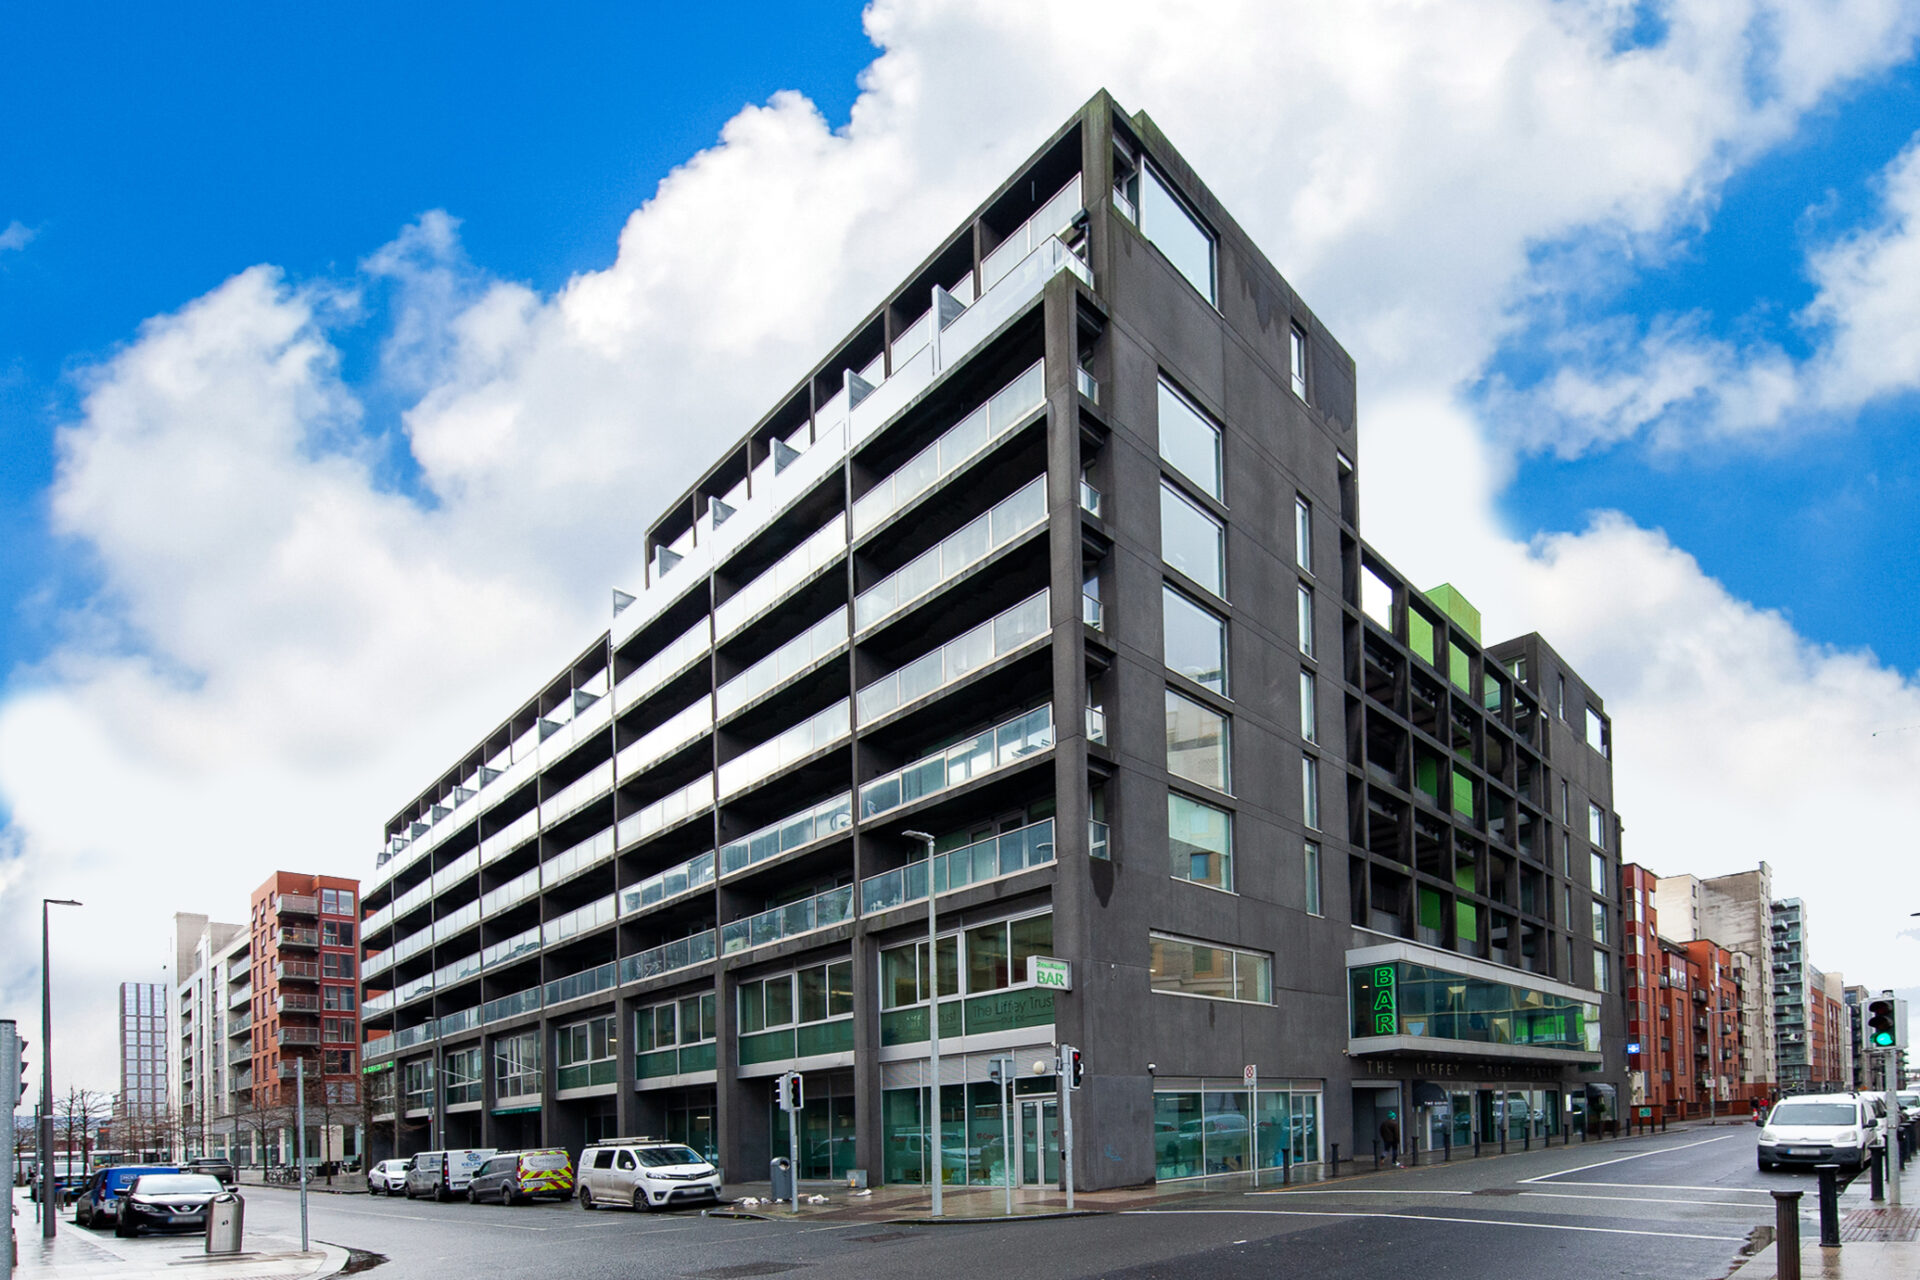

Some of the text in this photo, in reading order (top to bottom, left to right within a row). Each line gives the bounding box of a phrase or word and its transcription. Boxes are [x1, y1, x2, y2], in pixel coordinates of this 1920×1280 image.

[1037, 970, 1065, 987] BAR
[1374, 967, 1396, 1034] BAR
[972, 1005, 992, 1018] The
[996, 1001, 1026, 1015] Liffey
[1367, 1060, 1394, 1074] THE
[1416, 1063, 1460, 1076] LIFFEY
